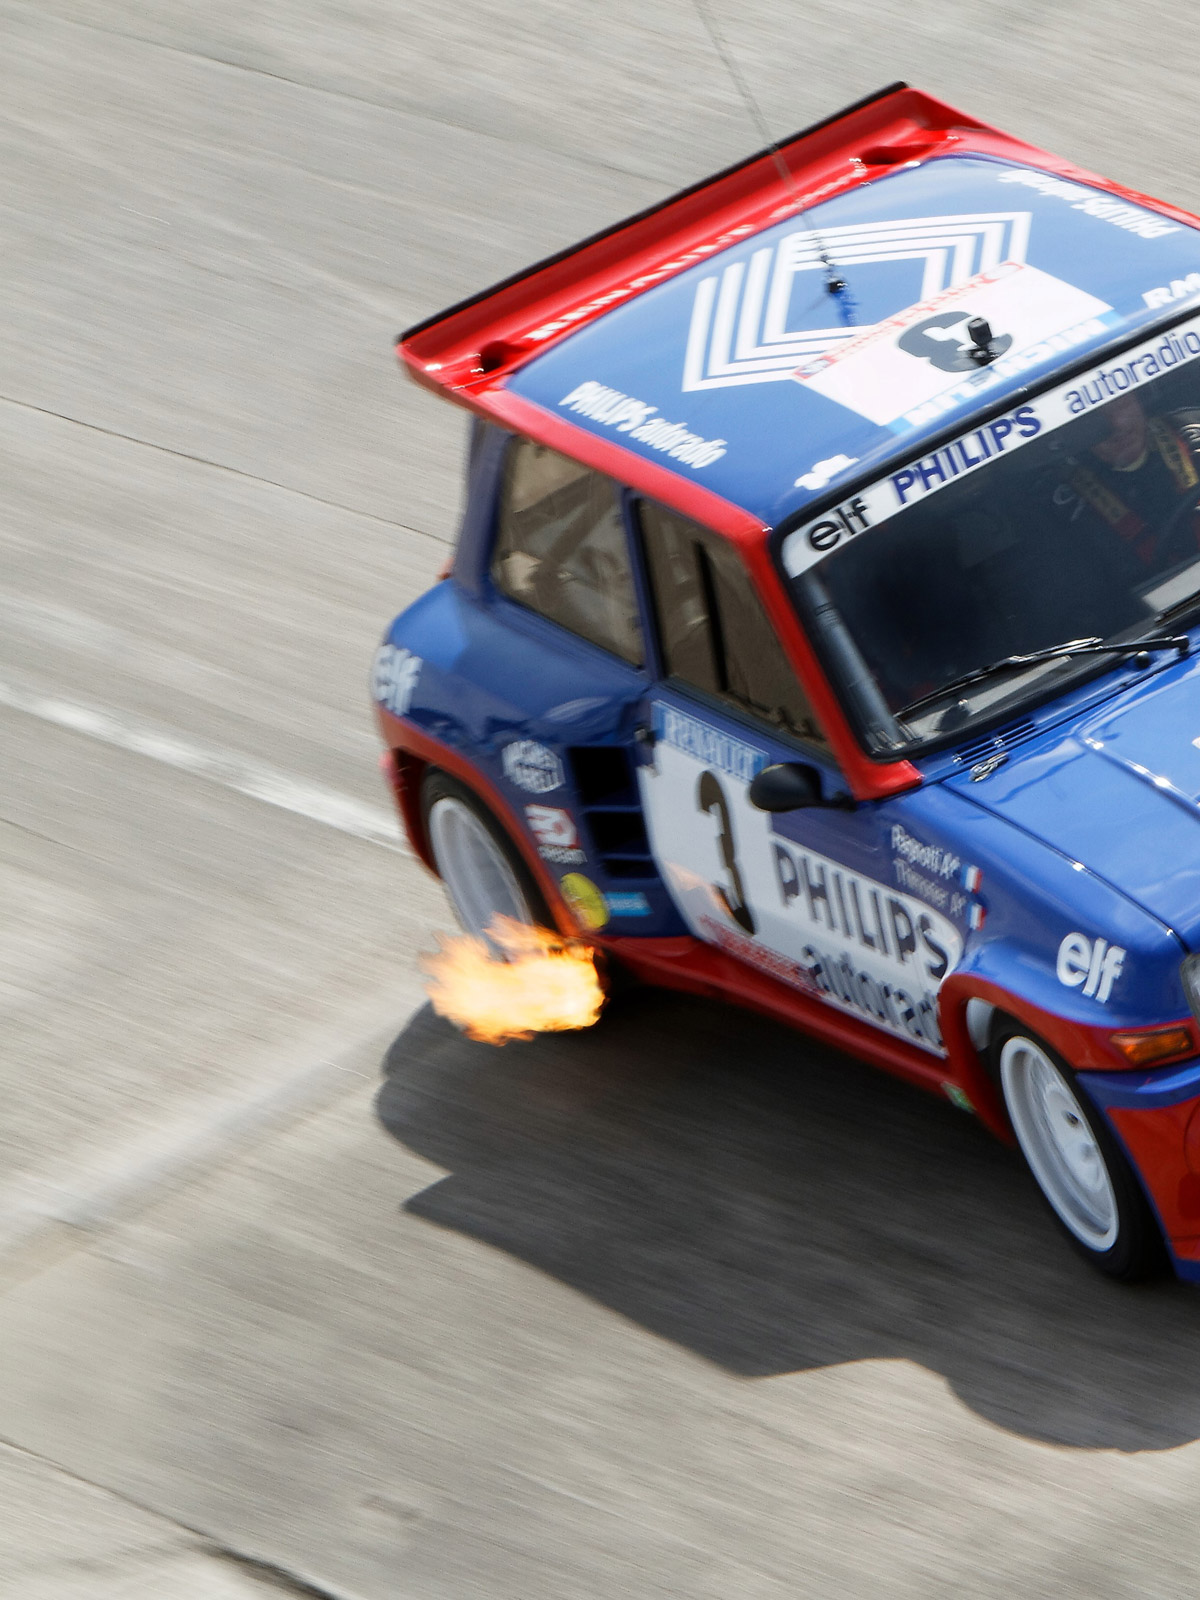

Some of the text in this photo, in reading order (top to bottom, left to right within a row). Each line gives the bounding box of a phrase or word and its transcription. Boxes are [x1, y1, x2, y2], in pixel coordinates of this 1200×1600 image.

[808, 498, 872, 552] elf
[889, 404, 1043, 506] PHILIPS
[696, 769, 758, 936] 3
[768, 840, 949, 983] PHILIPS
[1056, 930, 1127, 1005] elf
